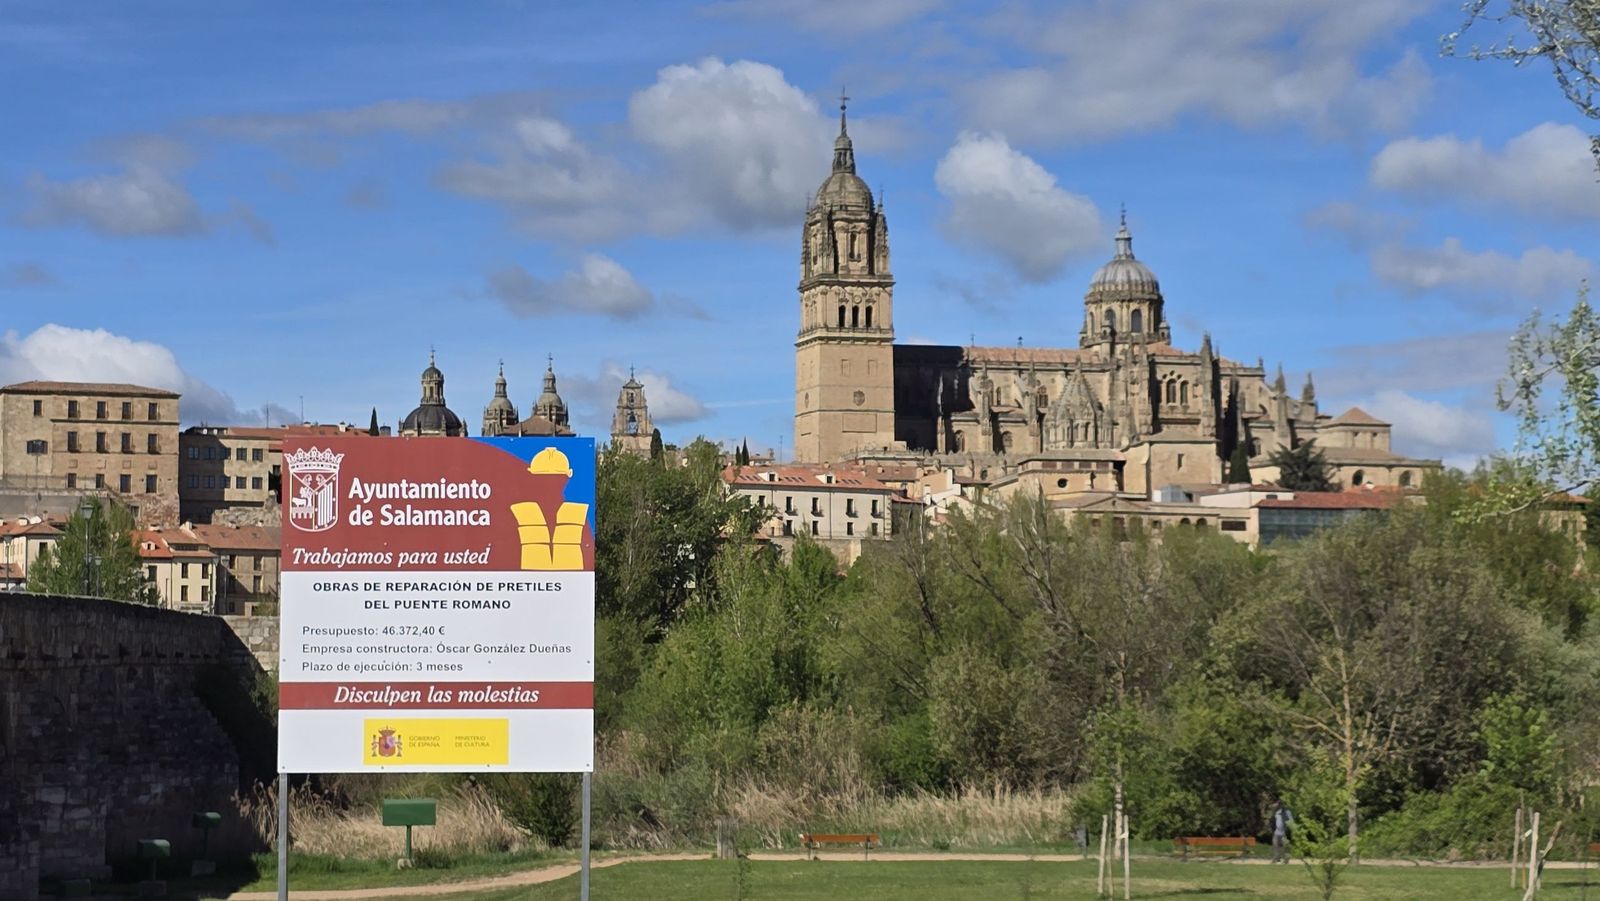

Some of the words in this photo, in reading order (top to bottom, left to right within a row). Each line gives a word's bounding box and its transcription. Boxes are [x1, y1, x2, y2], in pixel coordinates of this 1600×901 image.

[349, 477, 491, 503] Ayuntamiento
[349, 505, 373, 526] de
[380, 504, 491, 526] Salamanca
[292, 547, 393, 568] Trabajamos
[398, 551, 438, 567] para
[443, 547, 491, 565] usted
[313, 582, 359, 592] OBRAS
[364, 582, 381, 592] DE
[386, 580, 472, 592] REPARACIÓN
[477, 582, 493, 592] DE
[498, 582, 562, 592] PRETILES
[364, 600, 390, 610] DEL
[394, 600, 448, 610] PUENTE
[452, 600, 511, 610] ROMANO
[302, 625, 379, 637] Presupuesto:
[382, 625, 435, 637] 46.372,40
[438, 625, 445, 636] €
[302, 643, 353, 656] Empresa
[356, 643, 433, 654] constructora:
[436, 641, 470, 654] Óscar
[473, 642, 526, 654] González
[529, 643, 572, 654] Dueñas
[302, 661, 334, 672] Plazo
[337, 661, 351, 672] de
[353, 660, 413, 674] ejecución:
[416, 661, 423, 672] 3
[426, 663, 463, 672] meses
[334, 686, 421, 706] Disculpen
[427, 686, 452, 703] las
[458, 686, 540, 703] molestias
